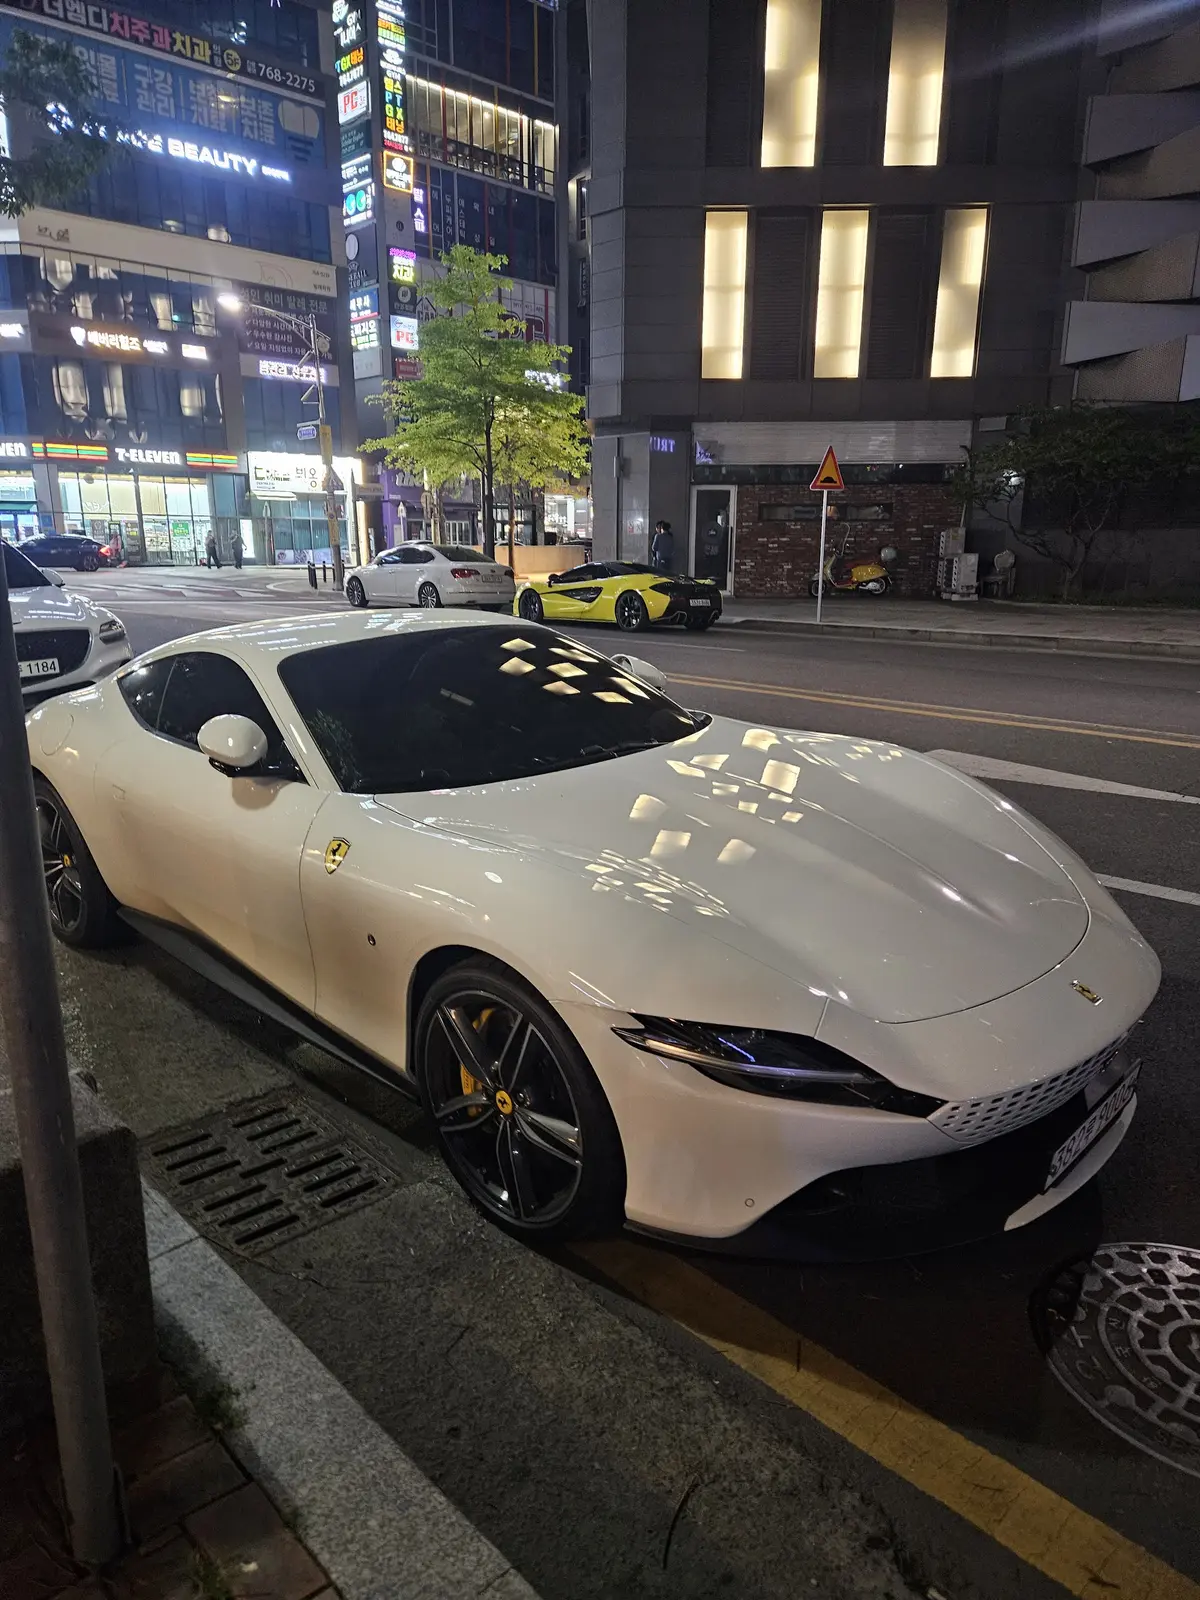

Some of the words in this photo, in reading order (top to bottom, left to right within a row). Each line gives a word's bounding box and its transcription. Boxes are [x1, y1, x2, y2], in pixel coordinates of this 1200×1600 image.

[134, 63, 173, 94] 구강
[258, 63, 316, 93] 768-2275
[136, 88, 176, 118] 관리
[343, 90, 358, 115] PC
[168, 138, 257, 176] BEAUTY
[26, 660, 57, 675] 1184
